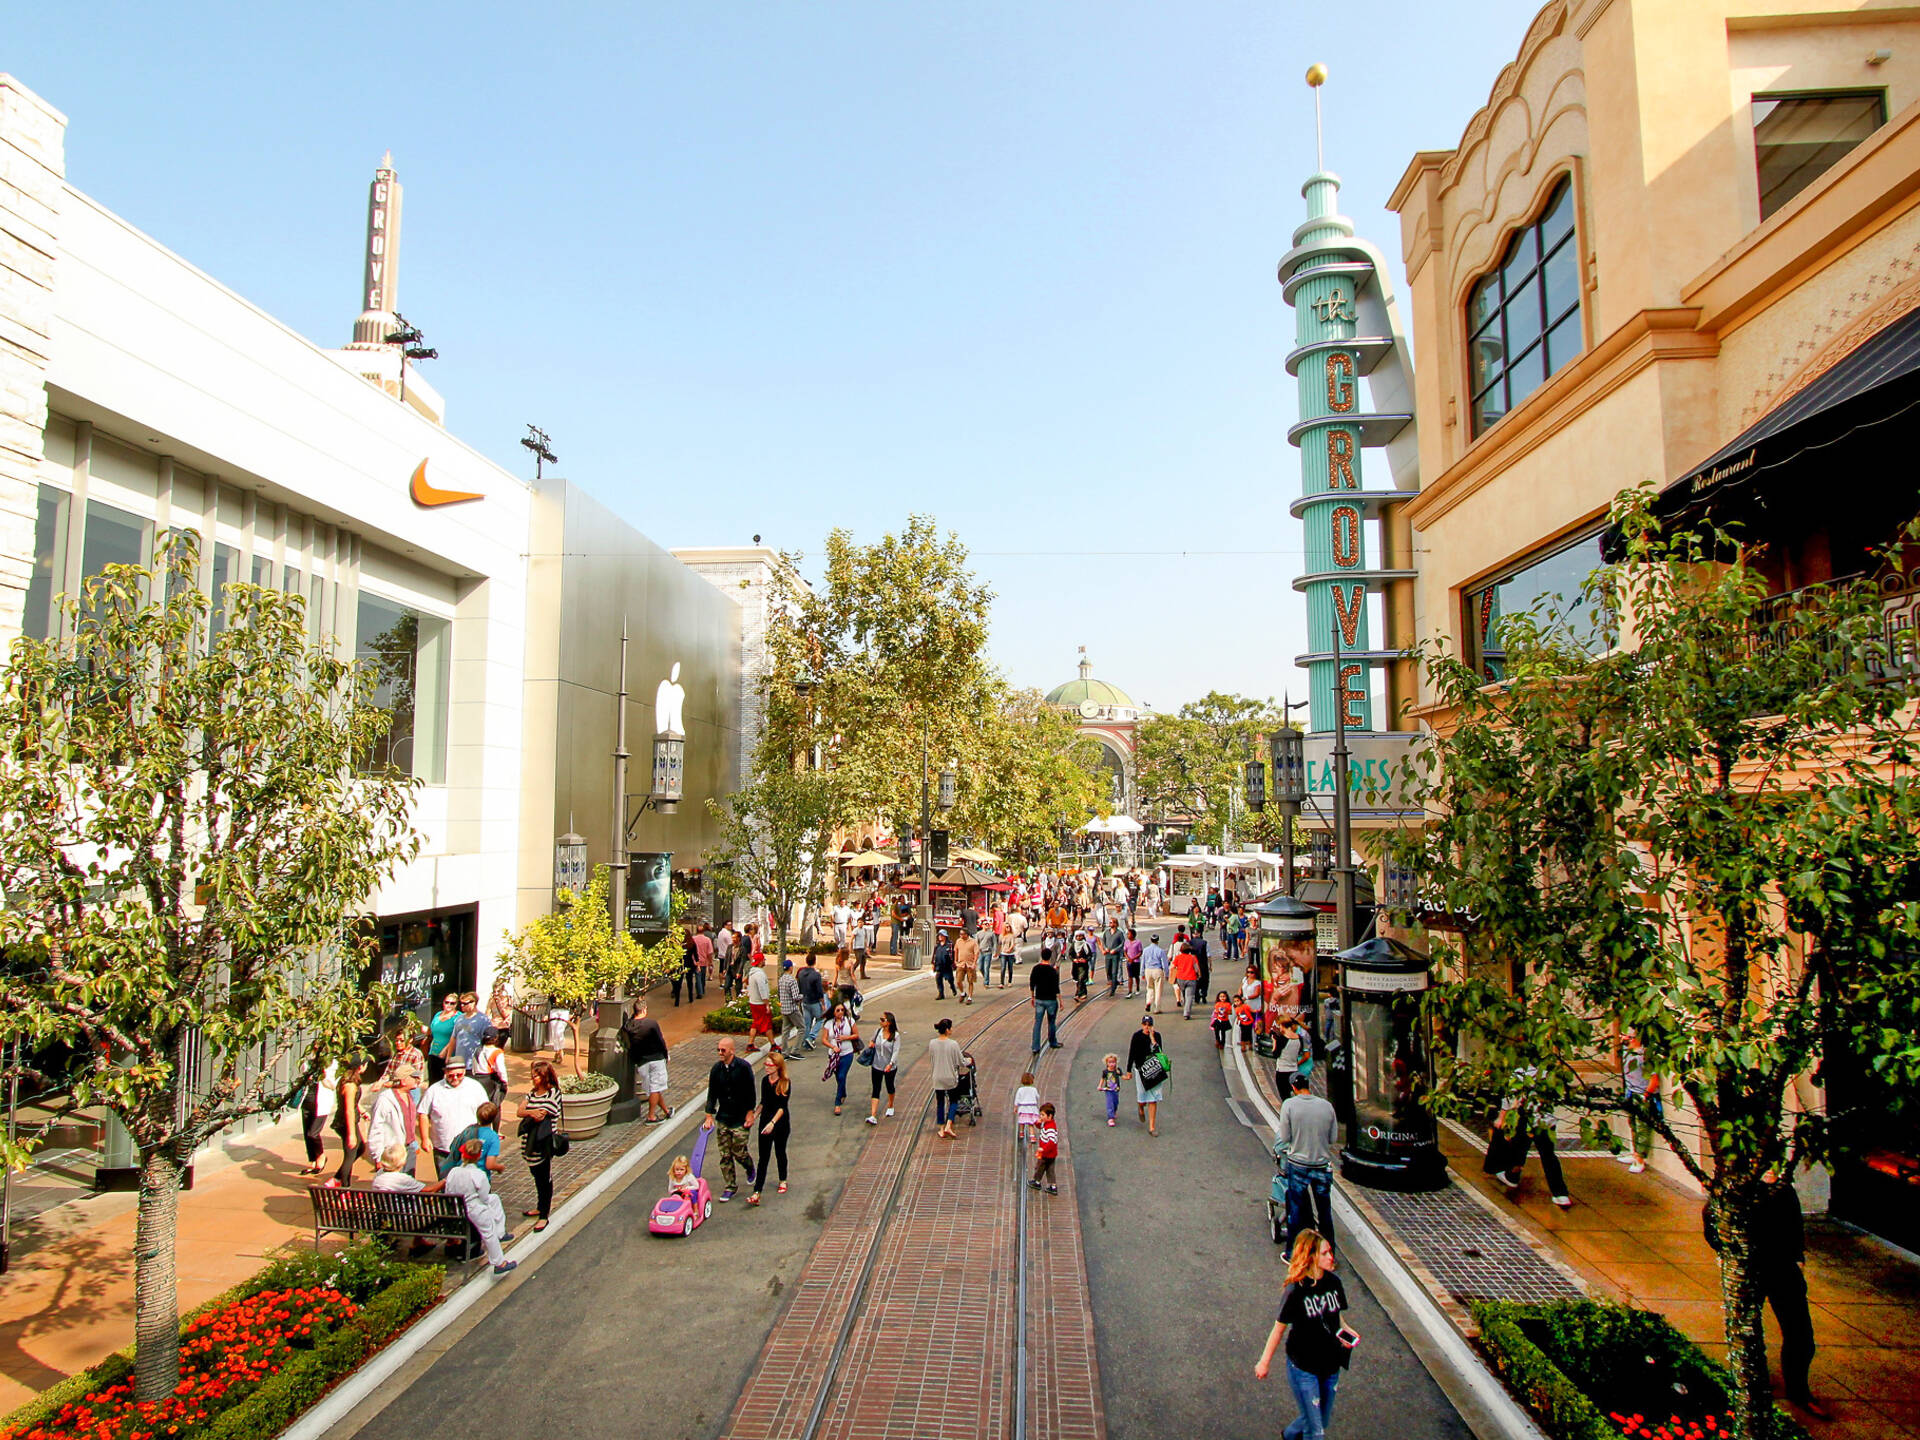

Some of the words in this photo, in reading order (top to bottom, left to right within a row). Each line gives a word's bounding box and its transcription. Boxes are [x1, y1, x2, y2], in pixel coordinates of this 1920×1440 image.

[369, 182, 386, 310] GROVE
[1691, 448, 1757, 494] Restaurant
[1326, 352, 1367, 728] GROVE
